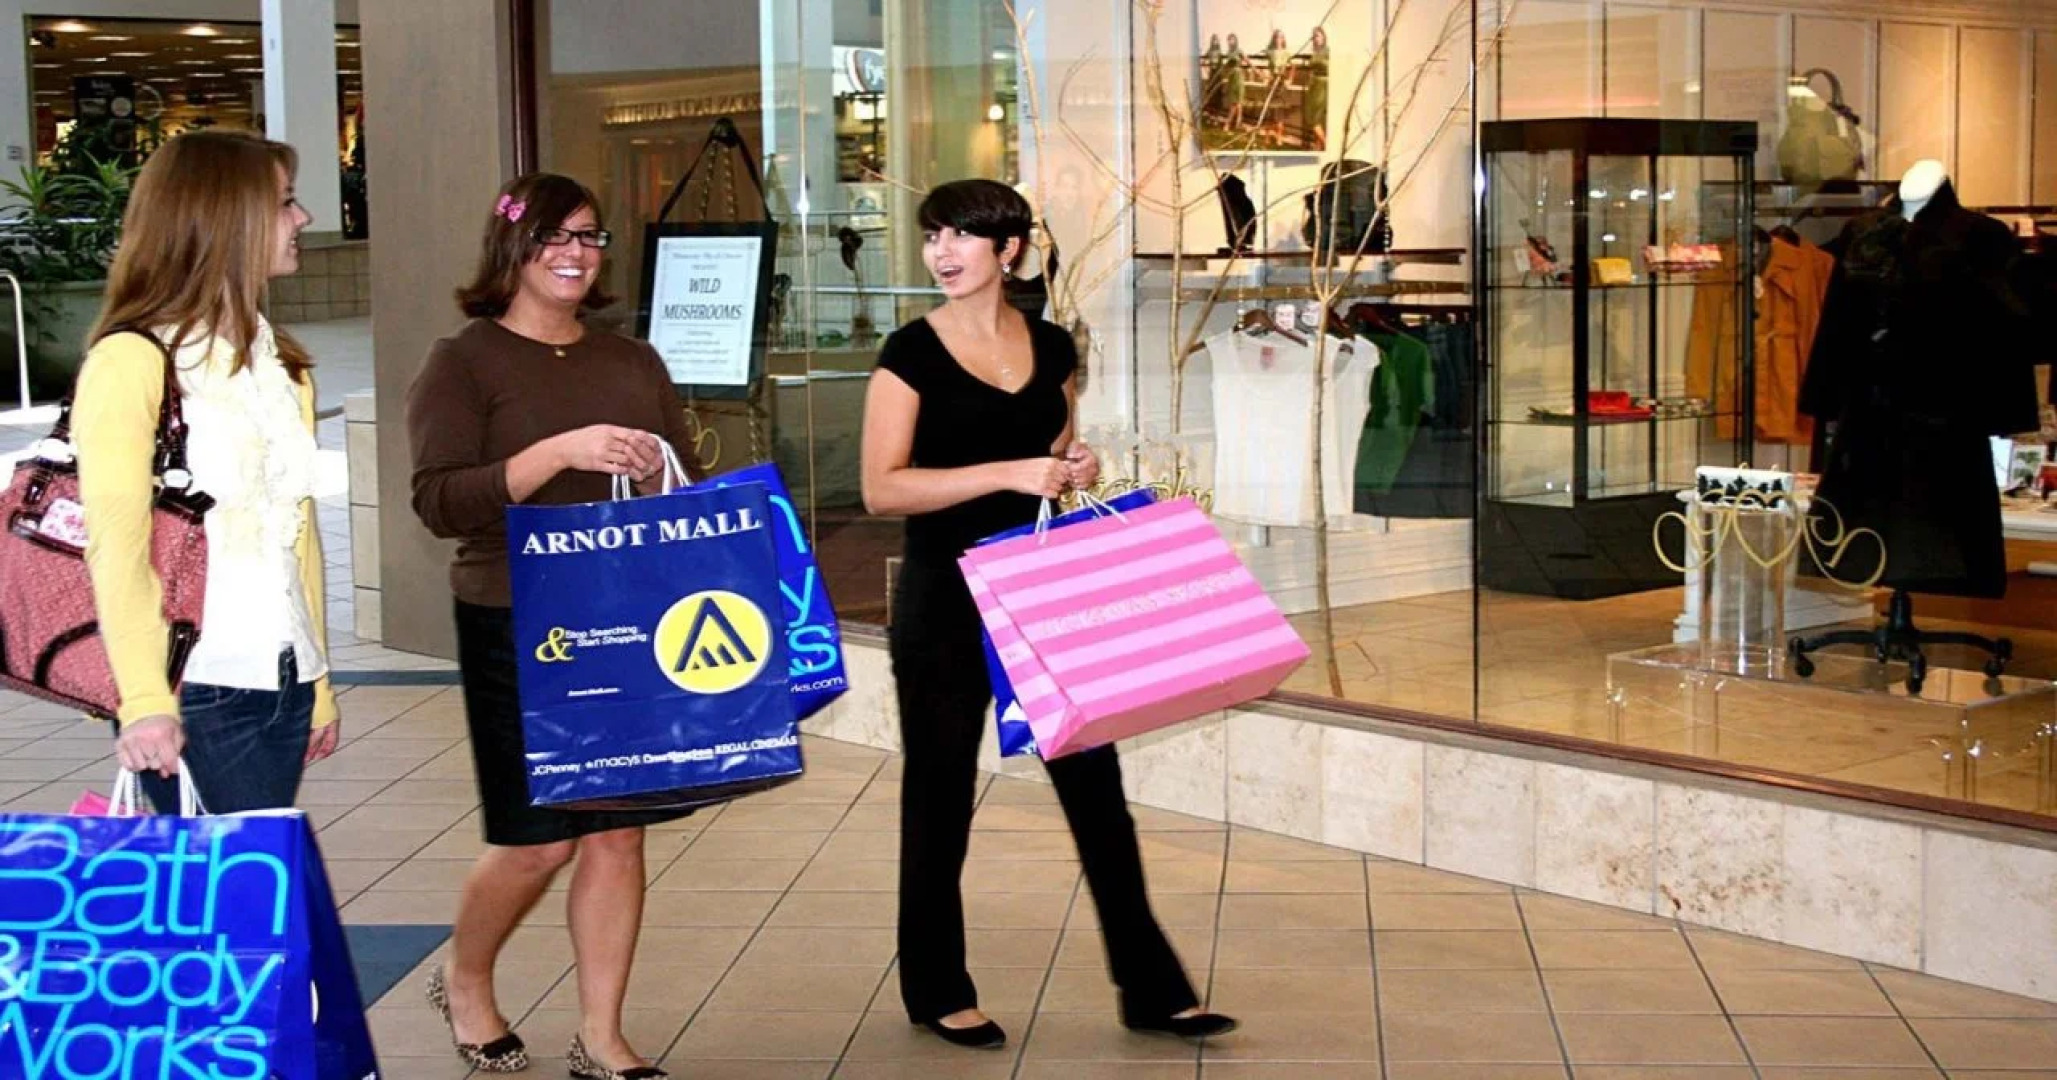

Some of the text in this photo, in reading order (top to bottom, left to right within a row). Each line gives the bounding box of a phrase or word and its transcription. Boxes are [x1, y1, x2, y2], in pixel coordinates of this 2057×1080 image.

[688, 277, 722, 294] WILD
[664, 303, 744, 321] MUSHROOMS
[522, 523, 649, 555] ARNOT
[657, 508, 762, 543] MALL
[589, 625, 639, 637] Searching
[602, 632, 648, 645] Shopping
[0, 823, 289, 935] Bath
